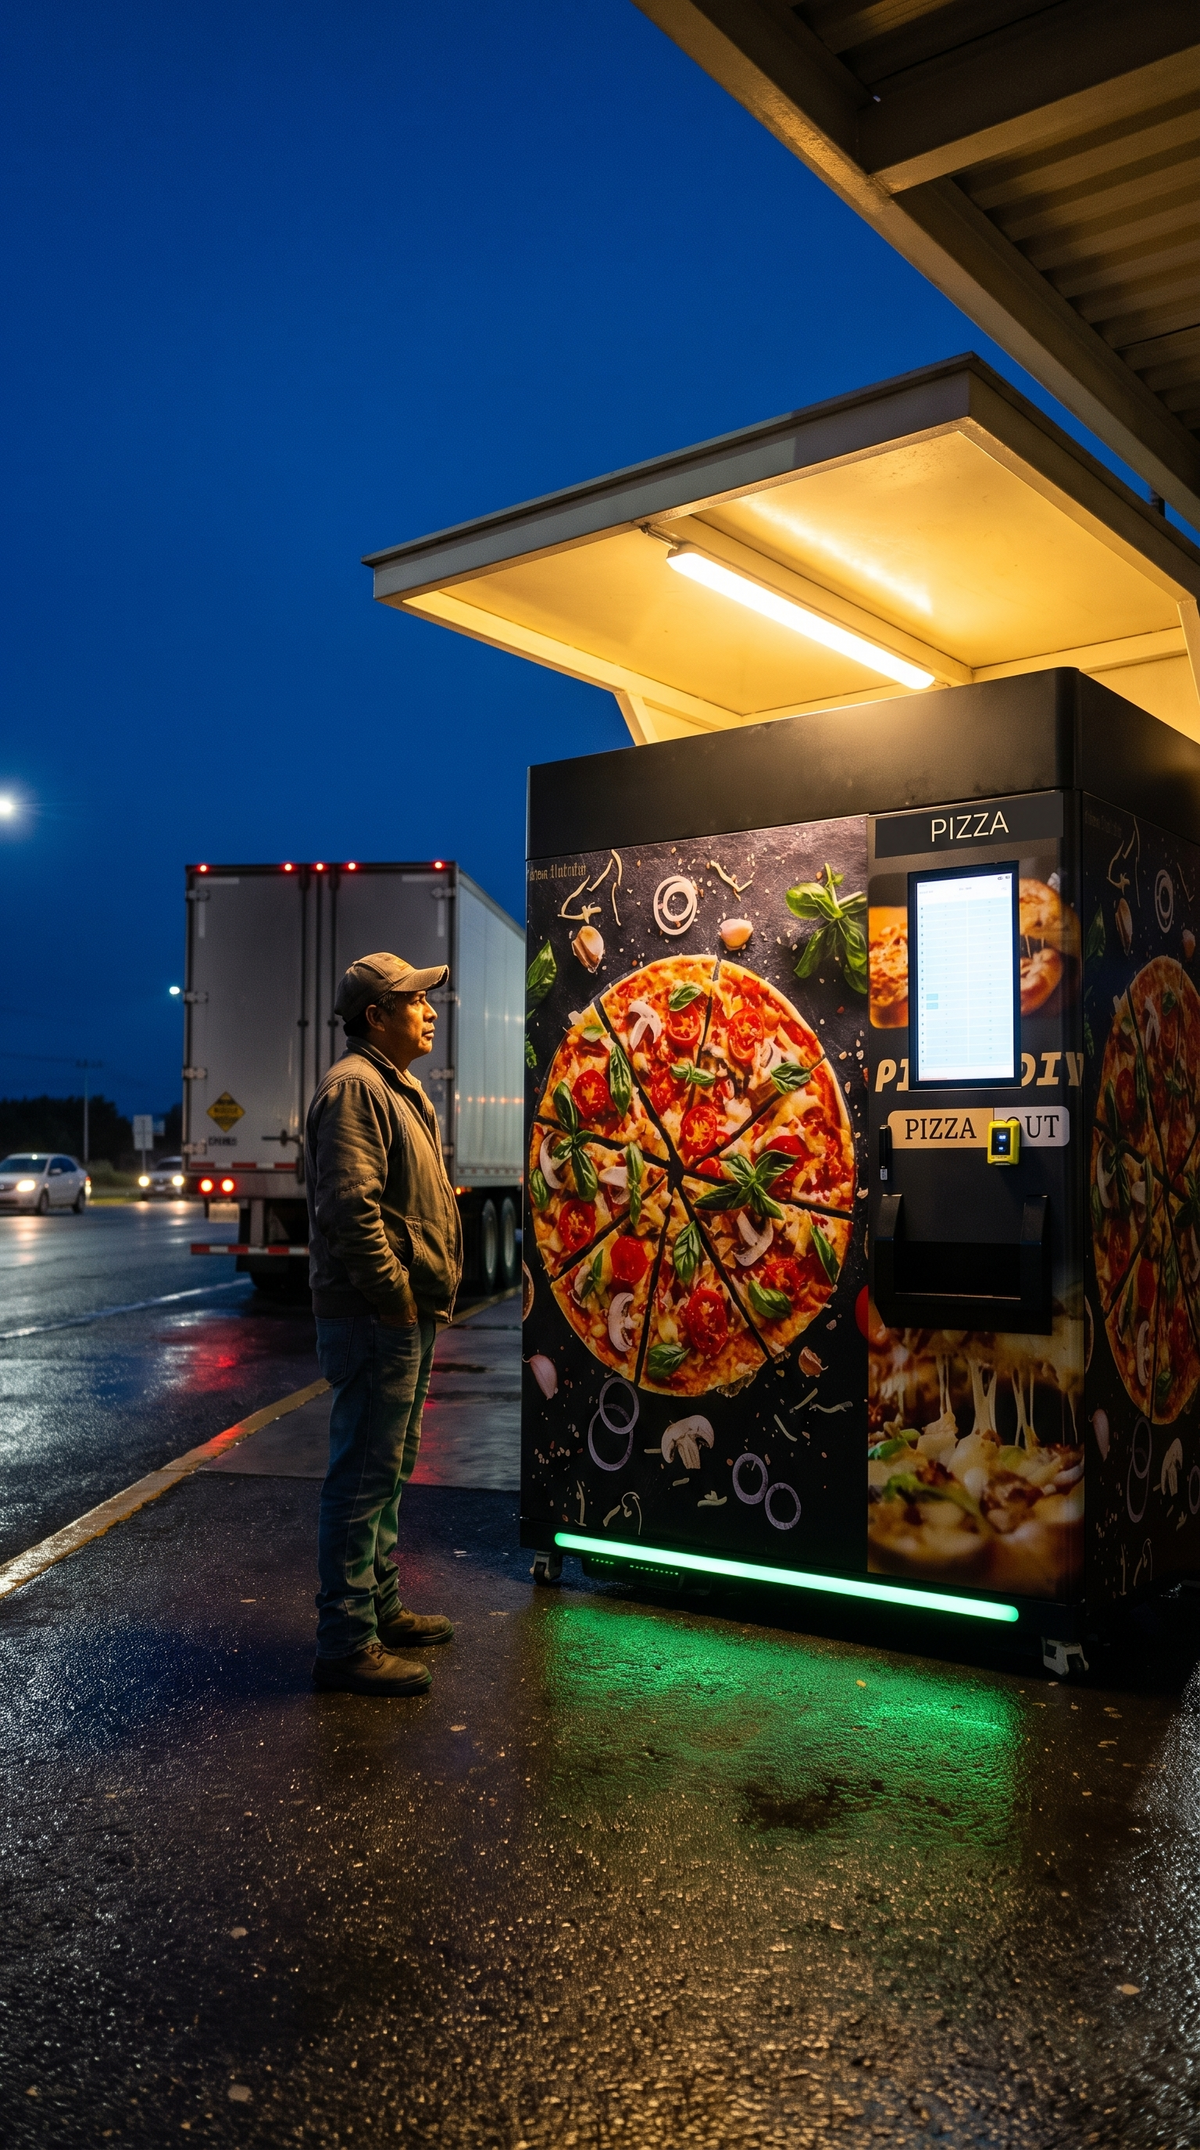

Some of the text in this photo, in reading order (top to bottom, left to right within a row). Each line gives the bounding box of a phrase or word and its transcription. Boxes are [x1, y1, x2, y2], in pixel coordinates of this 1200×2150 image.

[931, 810, 1010, 843] PIZZA
[904, 1114, 1060, 1140] PIZZA UT
